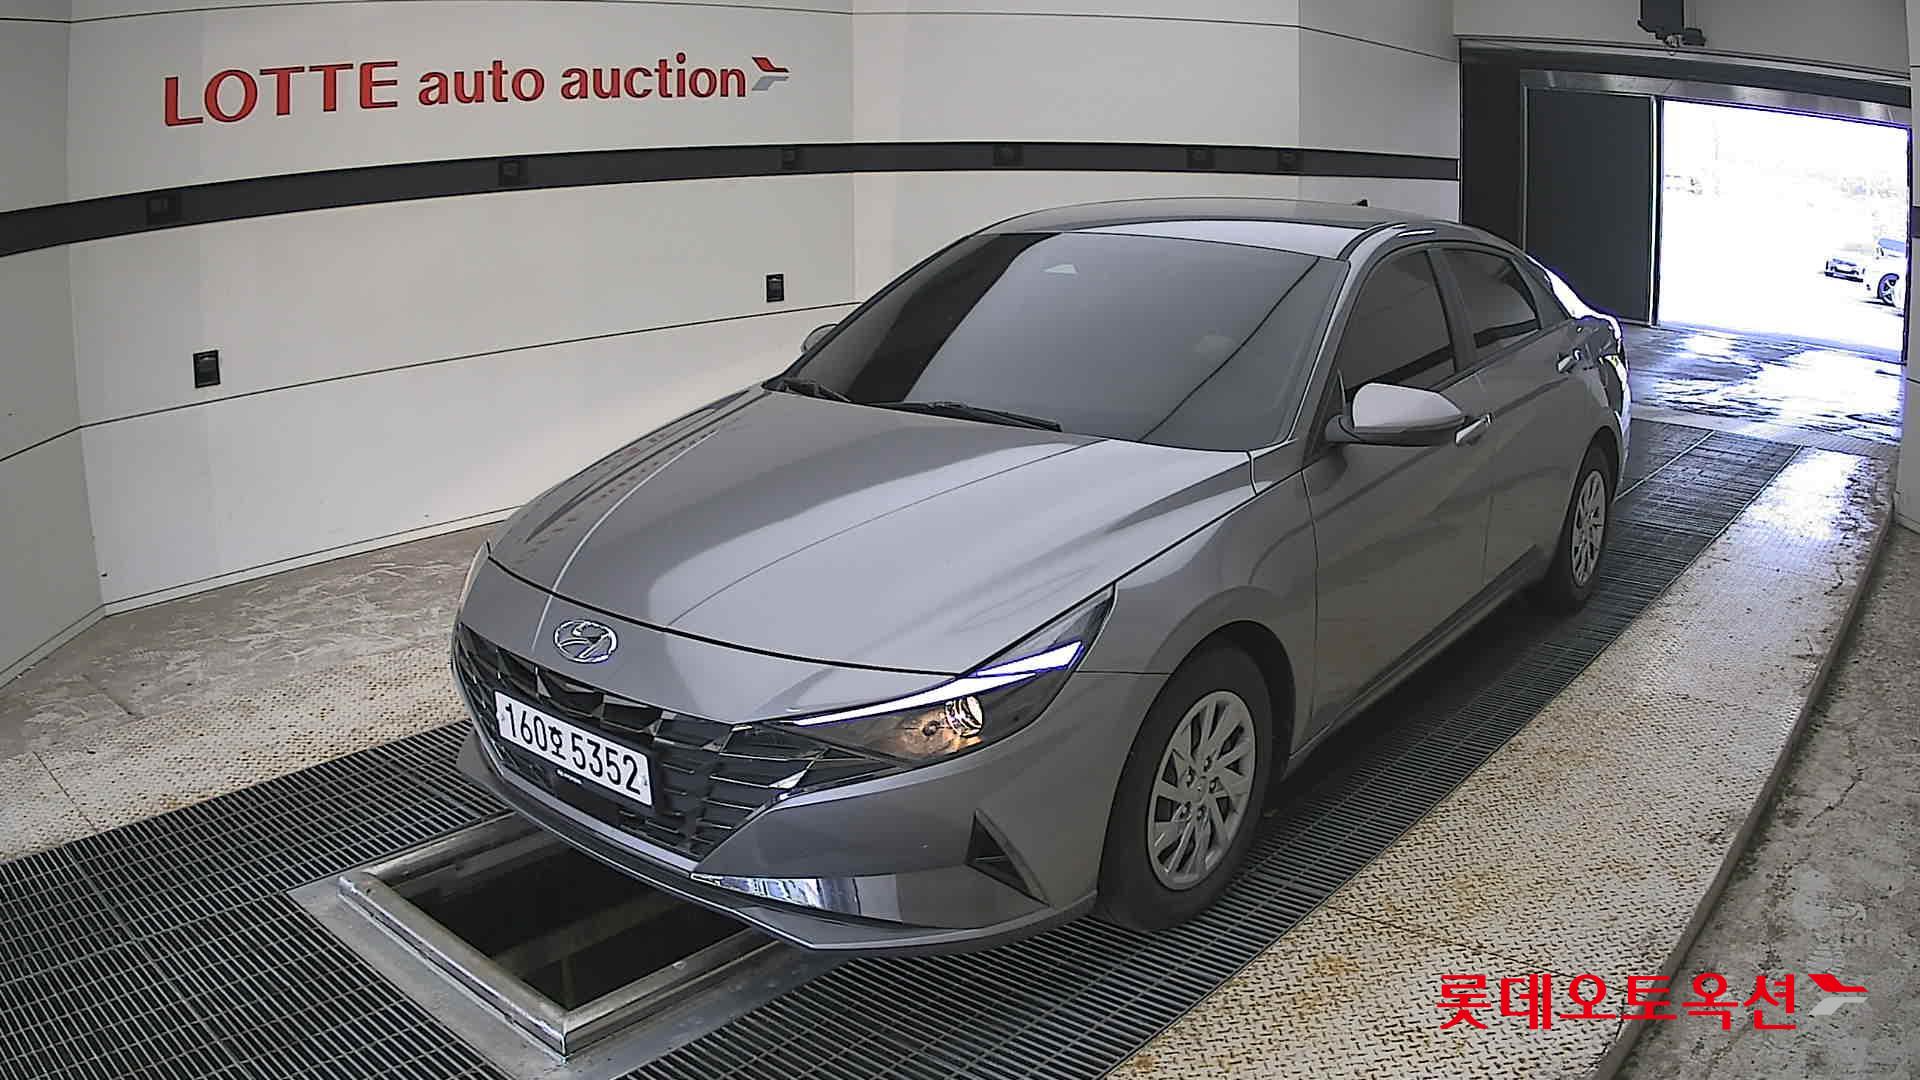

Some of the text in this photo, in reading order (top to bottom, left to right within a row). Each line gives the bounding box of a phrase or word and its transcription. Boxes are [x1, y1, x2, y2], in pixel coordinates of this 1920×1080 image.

[164, 53, 747, 126] LOTTE auto auction
